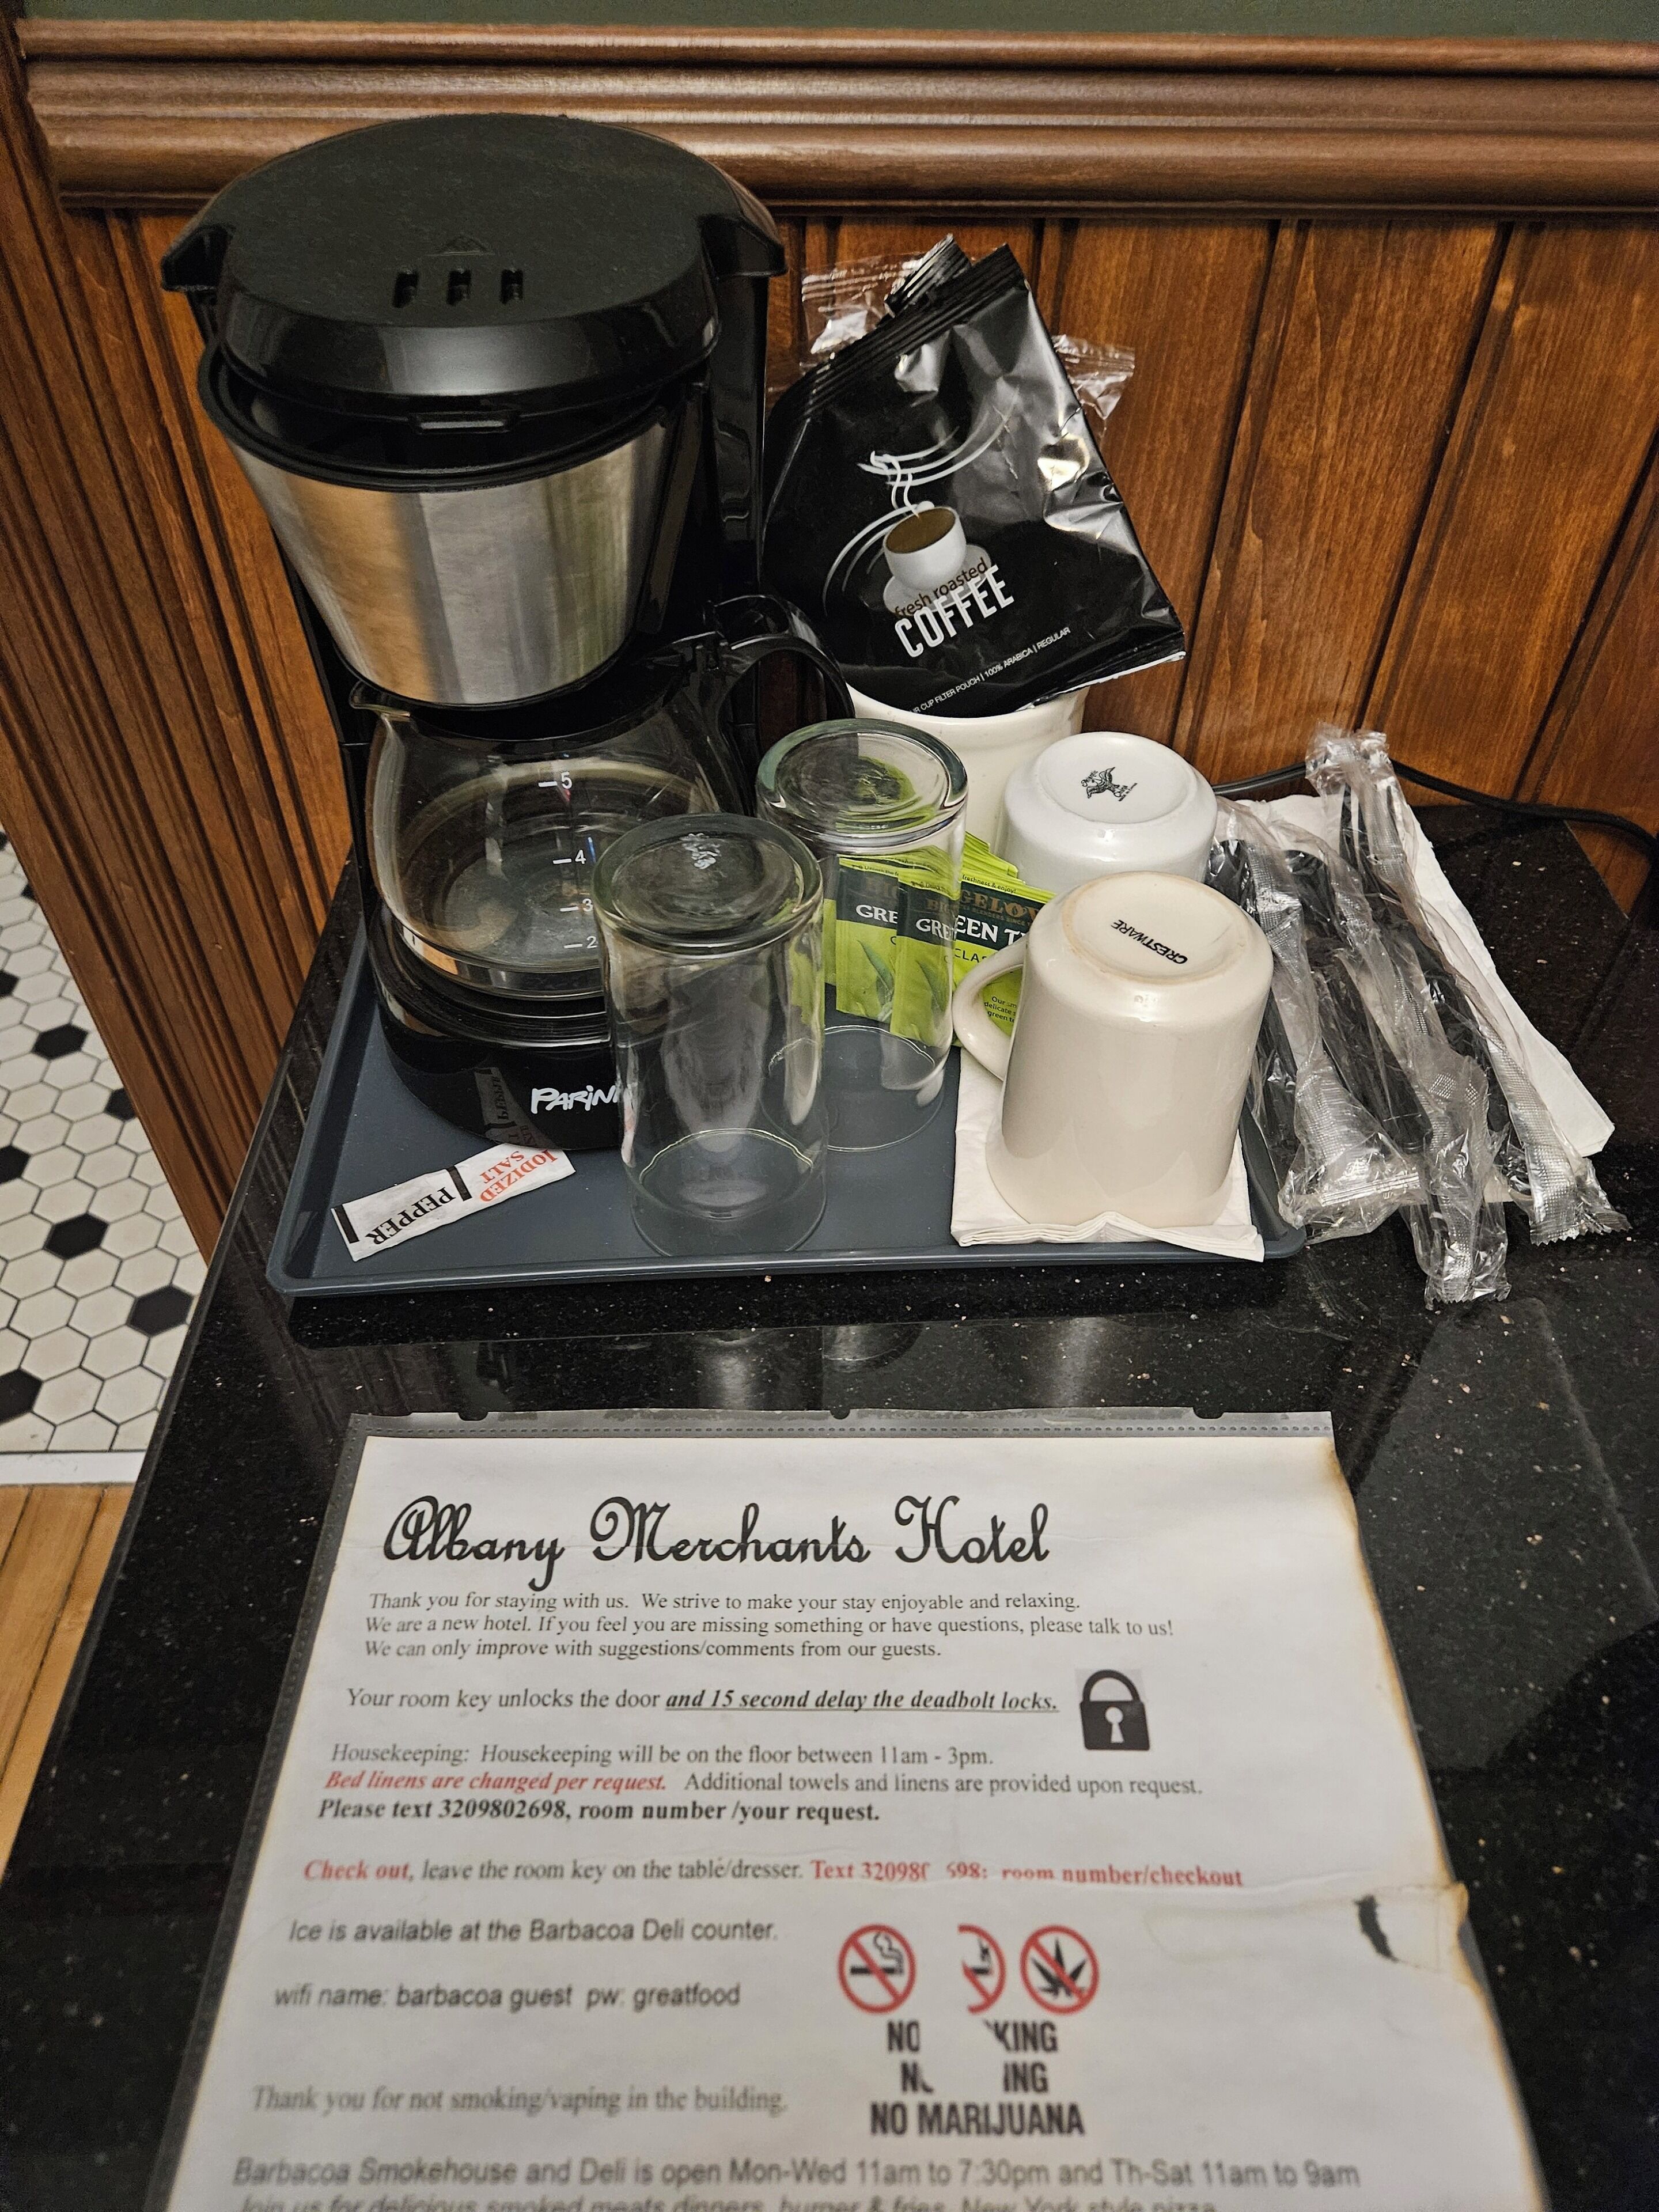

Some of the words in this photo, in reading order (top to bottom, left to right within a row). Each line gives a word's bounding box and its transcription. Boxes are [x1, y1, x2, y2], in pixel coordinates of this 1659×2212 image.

[895, 593, 932, 619] fresh
[933, 557, 988, 599] roasted
[895, 564, 1014, 657] COFFEE
[921, 699, 934, 711] CUP
[934, 689, 956, 703] FILTER
[956, 676, 980, 694] POUCH
[984, 664, 1003, 677] 100%
[1003, 647, 1033, 668] ARABICA
[1036, 627, 1071, 649] REGULAR
[560, 771, 573, 789] 5
[575, 849, 586, 864] 4
[961, 873, 991, 887] freshness
[582, 897, 594, 912] 3
[855, 904, 897, 924] GRE
[586, 935, 598, 949] 2
[1111, 919, 1188, 965] CRESTWARE
[479, 1150, 525, 1183] SALT
[480, 1149, 558, 1202] IODIZED
[365, 1187, 456, 1245] PEPPER
[383, 1495, 566, 1592] Albany
[590, 1497, 871, 1563] Merchants
[895, 1495, 1050, 1564] Hotel
[370, 1592, 422, 1609] Thank
[426, 1596, 459, 1611] you
[465, 1591, 491, 1607] for
[495, 1593, 557, 1613] staying
[563, 1593, 600, 1608] with
[606, 1597, 628, 1608] us.
[642, 1593, 668, 1608] We
[673, 1593, 720, 1609] strive
[726, 1597, 742, 1609] to
[747, 1593, 793, 1609] make
[798, 1599, 838, 1613] your
[843, 1597, 876, 1613] stay
[881, 1594, 963, 1613] enjoyable
[969, 1593, 1000, 1609] and
[1005, 1592, 1080, 1612] relaxing.
[366, 1617, 391, 1632] We
[397, 1621, 422, 1632] are
[427, 1620, 436, 1631] a
[442, 1619, 475, 1630] new
[484, 1615, 531, 1631] hotel.
[539, 1615, 554, 1635] If
[555, 1620, 590, 1637] you
[597, 1616, 627, 1631] feel
[632, 1621, 665, 1635] you
[671, 1621, 696, 1632] are
[702, 1617, 768, 1637] missing
[775, 1617, 863, 1637] something
[869, 1622, 887, 1633] or
[892, 1617, 931, 1633] have
[938, 1616, 1024, 1636] questions,
[1031, 1616, 1082, 1637] please
[1089, 1618, 1120, 1634] talk
[1126, 1622, 1142, 1634] to
[1148, 1620, 1173, 1635] us!
[365, 1641, 391, 1657] We
[396, 1645, 426, 1657] can
[431, 1639, 471, 1660] only
[476, 1638, 548, 1660] improve
[555, 1639, 592, 1656] with
[598, 1639, 794, 1661] suggestions/comments
[801, 1640, 841, 1657] from
[847, 1645, 877, 1656] our
[881, 1643, 941, 1661] guests.
[348, 1688, 394, 1707] Your
[399, 1694, 450, 1707] room
[456, 1689, 492, 1713] key
[498, 1688, 573, 1707] unlocks
[580, 1689, 609, 1708] the
[615, 1689, 661, 1708] door
[666, 1690, 706, 1707] and
[711, 1690, 734, 1707] 15
[740, 1690, 810, 1708] second
[815, 1690, 867, 1712] delay
[873, 1690, 904, 1709] the
[911, 1690, 995, 1709] deadbolt
[1002, 1691, 1056, 1710] locks.
[332, 1744, 469, 1767] Housekeeping:
[481, 1744, 611, 1767] Housekeeping
[619, 1745, 653, 1763] will
[660, 1745, 680, 1763] be
[687, 1750, 709, 1763] on
[715, 1745, 743, 1763] the
[749, 1745, 791, 1763] floor
[798, 1745, 872, 1764] between
[882, 1746, 927, 1764] 11am
[949, 1747, 993, 1770] 3pm.
[325, 1771, 365, 1788] Bed
[368, 1771, 425, 1788] linens
[432, 1777, 463, 1788] are
[469, 1772, 552, 1794] changed
[554, 1775, 588, 1794] per
[592, 1775, 666, 1796] request.
[684, 1772, 782, 1791] Additional
[789, 1773, 849, 1791] towels
[855, 1774, 888, 1791] and
[895, 1773, 949, 1792] linens
[955, 1779, 983, 1792] are
[989, 1773, 1071, 1797] provided
[1077, 1780, 1123, 1798] upon
[1129, 1780, 1202, 1799] request.
[317, 1798, 386, 1819] Please
[392, 1801, 433, 1819] text
[438, 1799, 571, 1823] 3209802698,
[578, 1805, 634, 1820] room
[642, 1800, 727, 1820] number
[731, 1800, 790, 1825] /your
[796, 1804, 880, 1826] request.
[304, 1859, 369, 1881] Check
[374, 1862, 414, 1883] out,
[421, 1859, 474, 1881] leave
[478, 1859, 509, 1880] the
[513, 1863, 565, 1880] room
[570, 1858, 606, 1885] key
[612, 1864, 636, 1880] on
[642, 1859, 672, 1880] the
[678, 1857, 803, 1880] table/dresser.
[810, 1859, 854, 1880] Text
[1001, 1865, 1055, 1881] room
[1062, 1863, 1244, 1888] number/checkout
[289, 1919, 323, 1942] Ice
[328, 1920, 347, 1942] is
[353, 1919, 453, 1942] available
[459, 1920, 482, 1942] at
[487, 1919, 522, 1942] the
[529, 1918, 635, 1942] Barbacoa
[642, 1918, 684, 1942] Deli
[691, 1919, 777, 1941] counter.
[274, 1983, 312, 2007] wifi
[317, 1988, 388, 2008] name:
[395, 1983, 503, 2009] barbacoa
[509, 1983, 573, 2014] guest
[585, 1987, 624, 2012] pw:
[632, 1982, 741, 2014] greatfood
[887, 2020, 921, 2054] NO
[1002, 2063, 1048, 2093] ING
[870, 2101, 908, 2137] NO
[918, 2102, 1086, 2137] MARIJUANA
